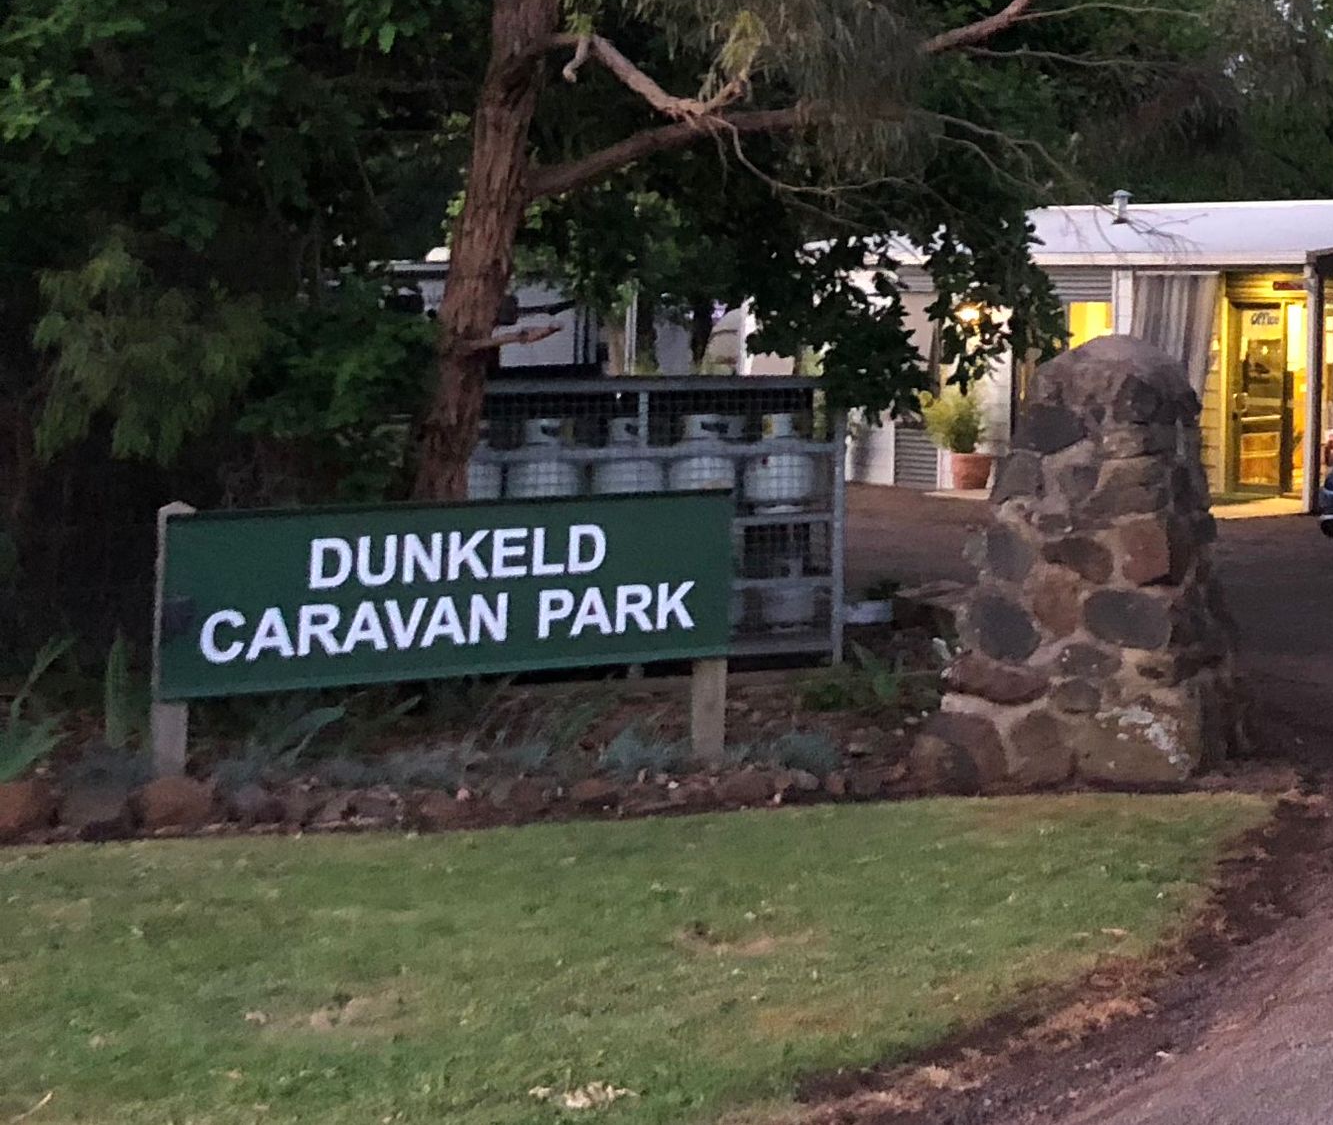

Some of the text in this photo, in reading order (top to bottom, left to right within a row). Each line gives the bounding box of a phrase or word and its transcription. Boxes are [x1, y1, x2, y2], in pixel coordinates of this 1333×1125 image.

[308, 523, 607, 591] DUNKELD
[199, 580, 696, 665] CARAVAN PARK
